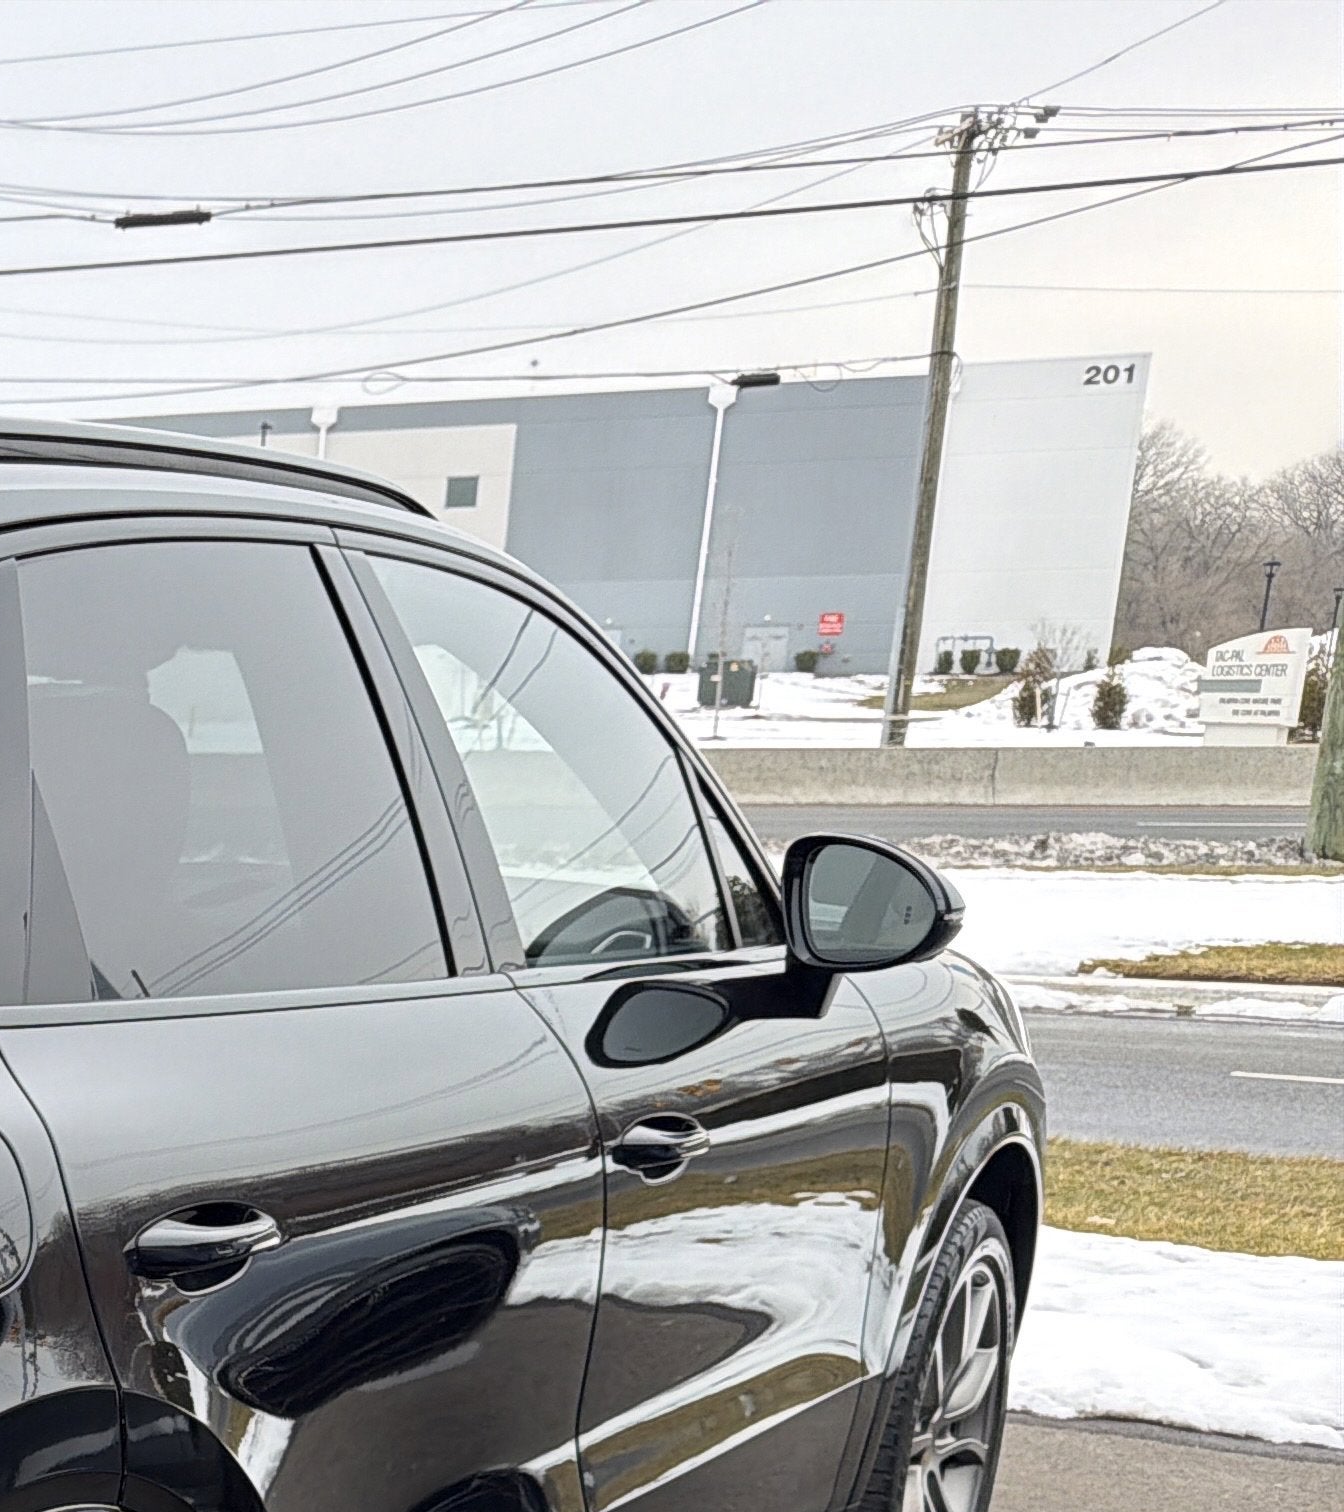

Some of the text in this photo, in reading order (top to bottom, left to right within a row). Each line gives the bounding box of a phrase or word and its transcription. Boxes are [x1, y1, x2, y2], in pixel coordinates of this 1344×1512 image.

[1083, 363, 1136, 385] 201
[1212, 663, 1288, 677] LOGISTICS CENTER
